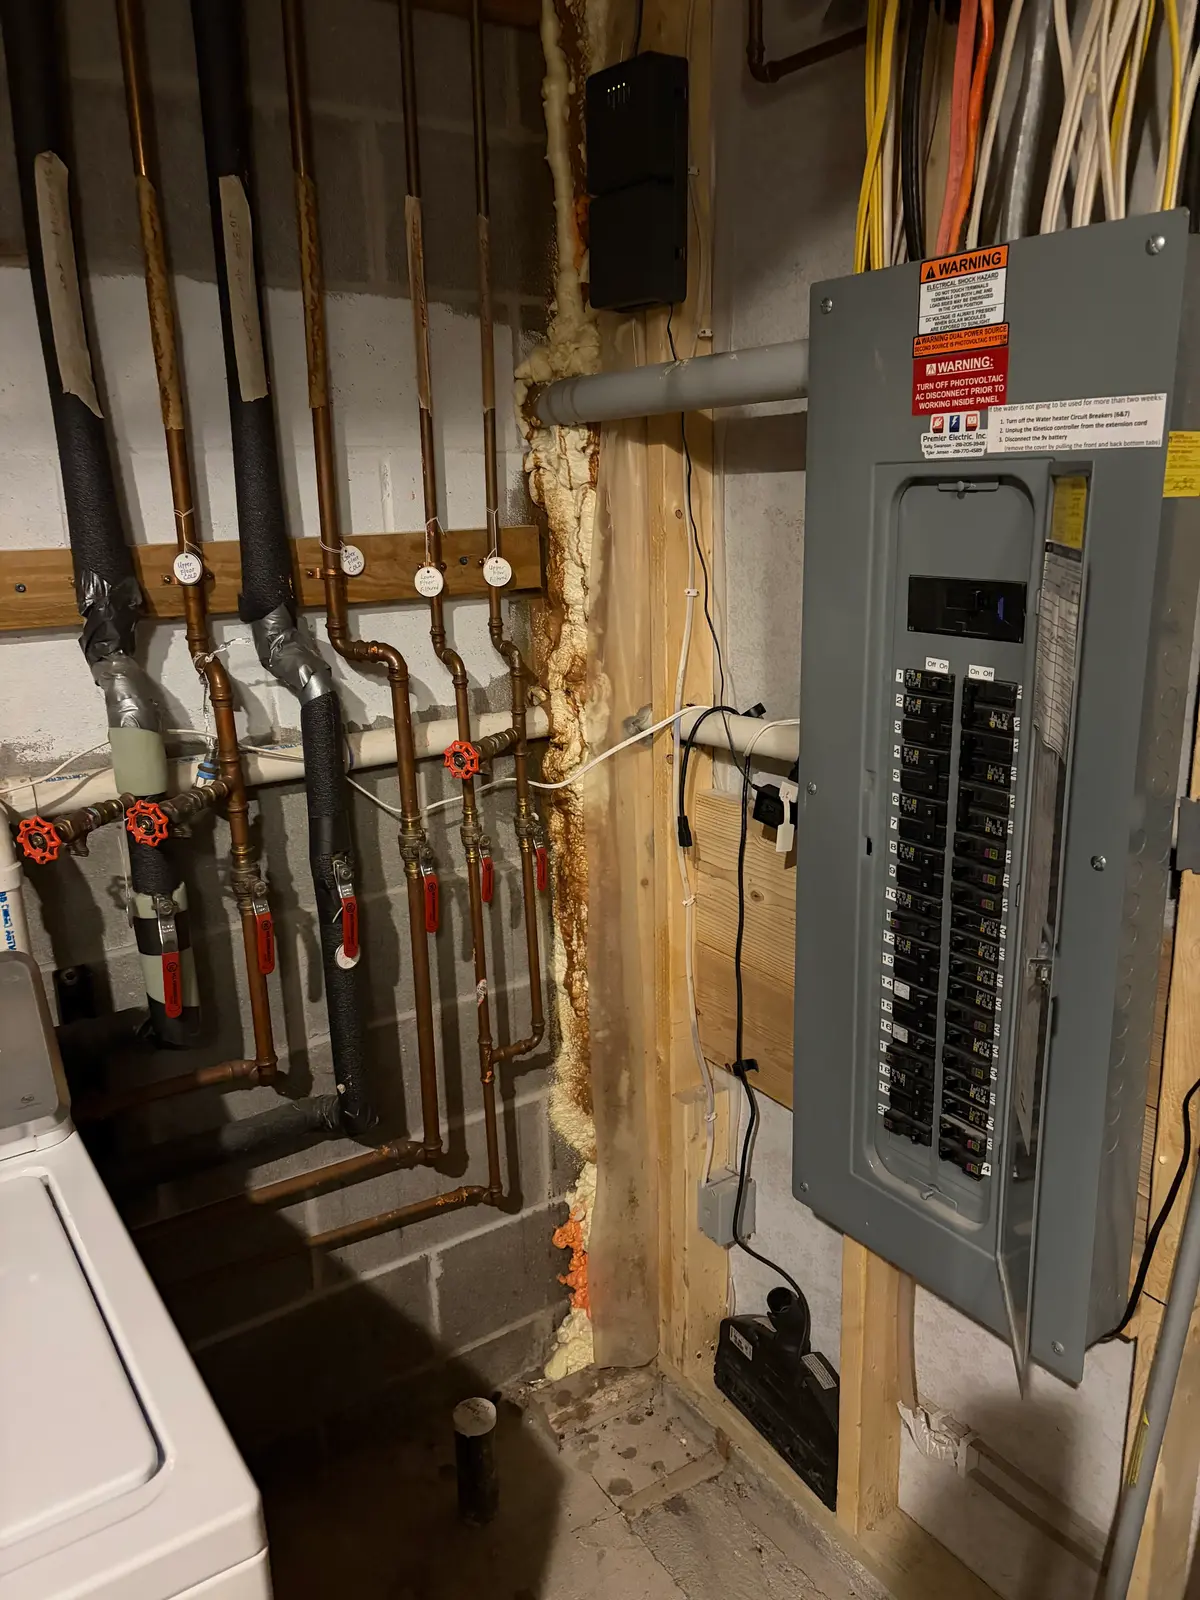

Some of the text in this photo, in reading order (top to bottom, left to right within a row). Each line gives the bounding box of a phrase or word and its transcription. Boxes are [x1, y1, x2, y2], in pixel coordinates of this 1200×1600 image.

[938, 252, 1001, 276] WARNING
[927, 281, 956, 290] ELECTRICAL
[977, 272, 998, 280] HAZARD
[922, 334, 948, 344] WARNING
[964, 329, 983, 337] POWER
[984, 326, 1006, 334] SOURCE
[955, 337, 987, 346] PHOTOVOLTAIC
[938, 356, 993, 373] WARNING:
[950, 374, 1003, 387] PHOTOVOLTAIC
[926, 388, 968, 399] DISCONNECT
[971, 385, 992, 394] PRIOR
[919, 395, 998, 410] WORKING INSIDE PANEL
[884, 932, 894, 941] 12
[883, 955, 893, 964] 13
[883, 978, 892, 987] 14
[882, 1001, 892, 1010] 15
[882, 1021, 892, 1030] 16
